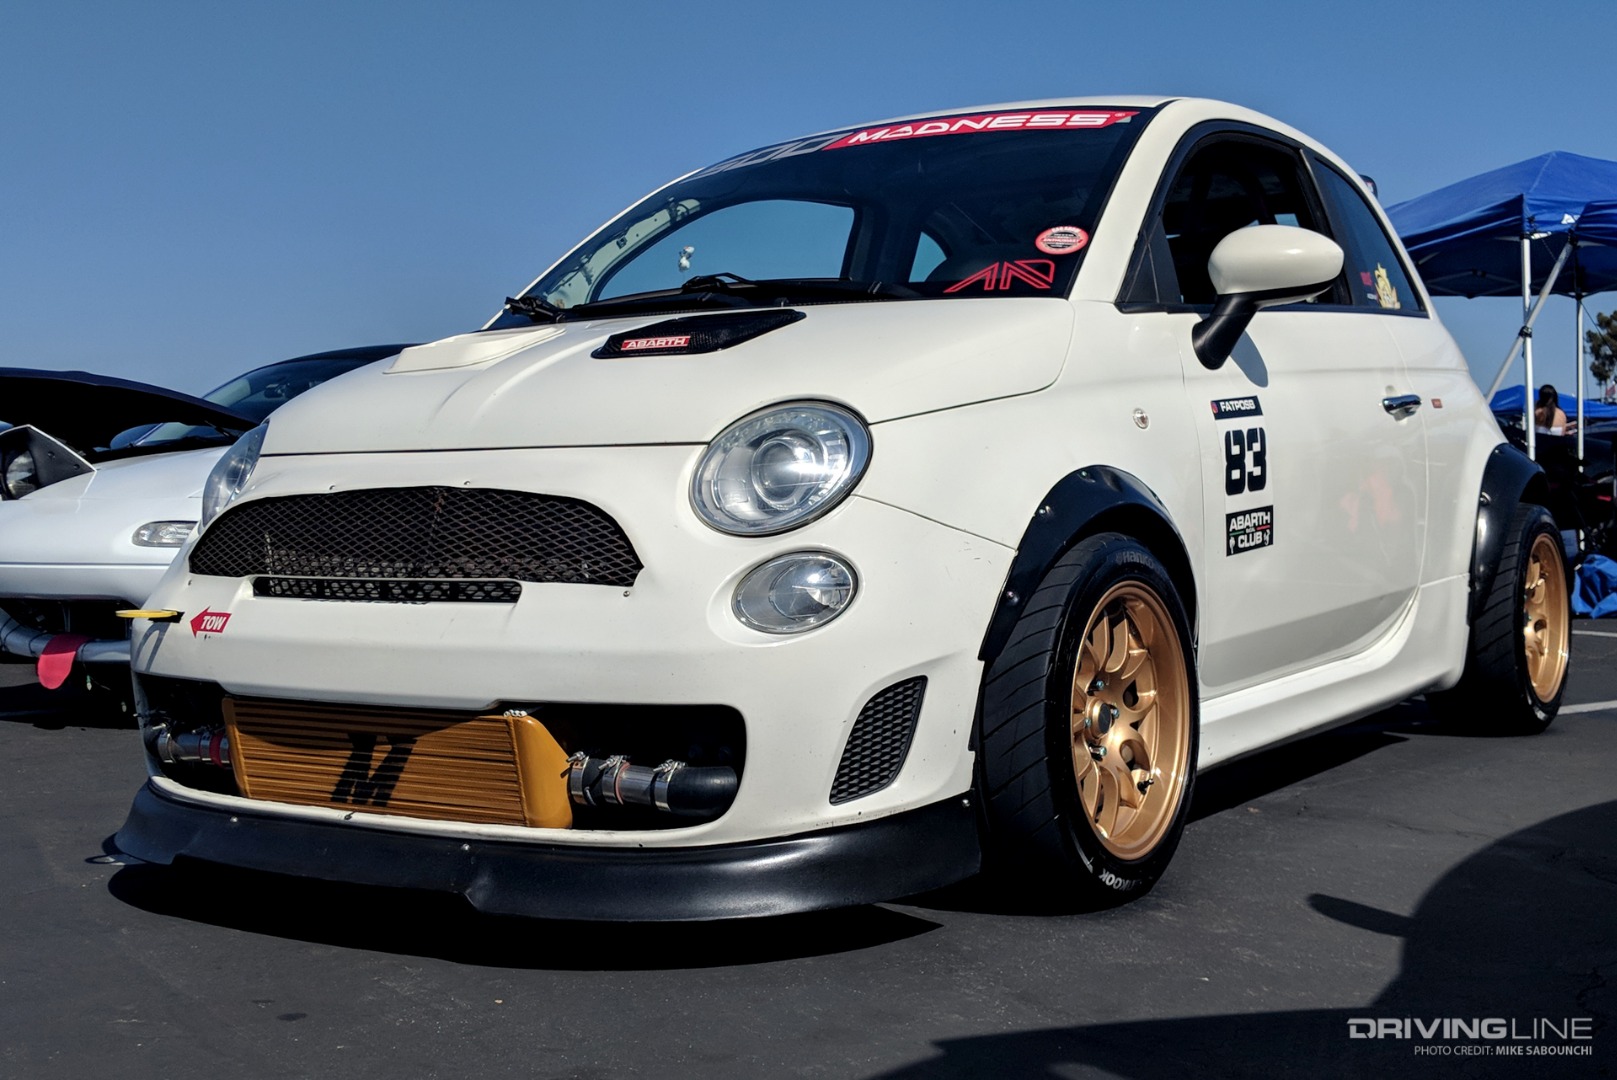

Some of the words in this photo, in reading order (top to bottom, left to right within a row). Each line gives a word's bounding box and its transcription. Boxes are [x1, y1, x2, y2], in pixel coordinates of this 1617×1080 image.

[848, 113, 1110, 144] MADNESS
[626, 337, 686, 349] ABARTH
[1224, 427, 1267, 496] 83
[1229, 511, 1271, 532] ABARTH
[1237, 531, 1263, 549] CLUB
[200, 615, 228, 631] TOW
